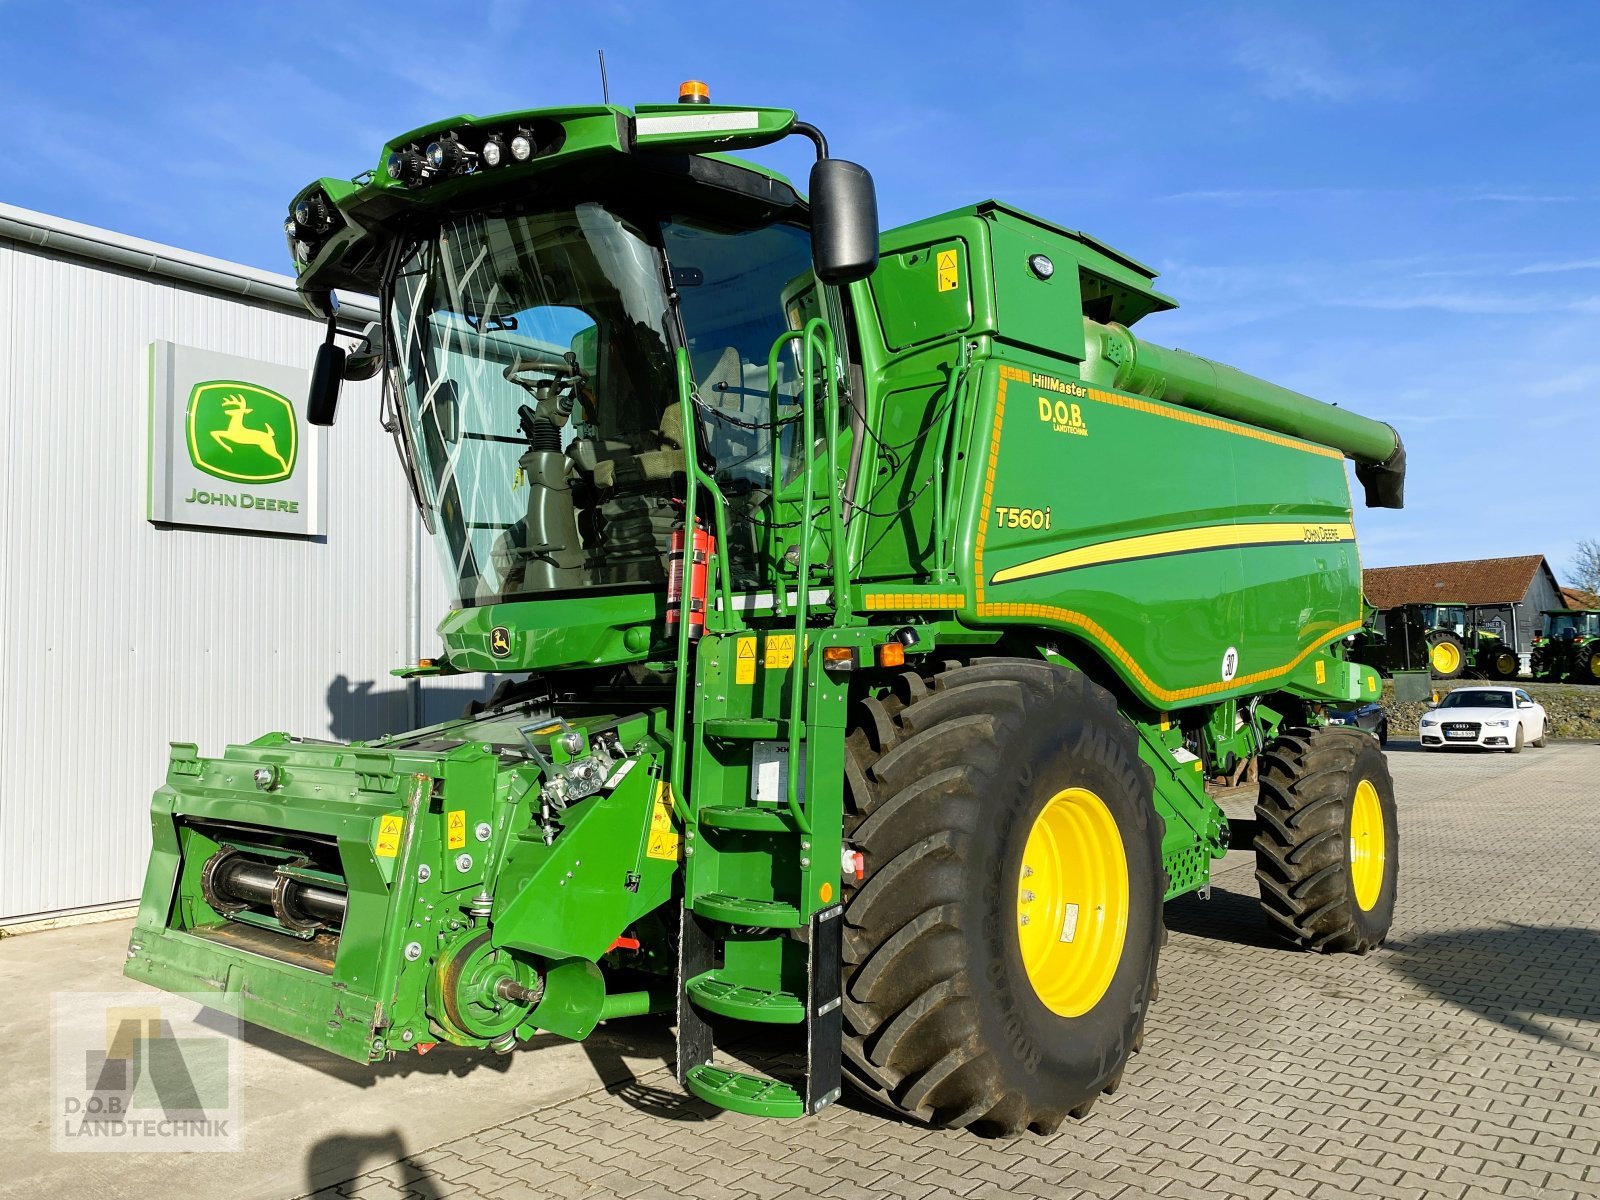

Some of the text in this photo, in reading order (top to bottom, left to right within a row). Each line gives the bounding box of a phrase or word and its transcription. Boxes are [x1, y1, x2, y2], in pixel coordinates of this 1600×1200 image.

[1032, 372, 1087, 398] HillMaster
[1038, 397, 1086, 428] D.O.B.
[1053, 424, 1089, 436] LANDTECHNIK
[185, 487, 299, 513] JOHN DEERE
[995, 506, 1051, 530] T560i
[1224, 653, 1235, 677] 30
